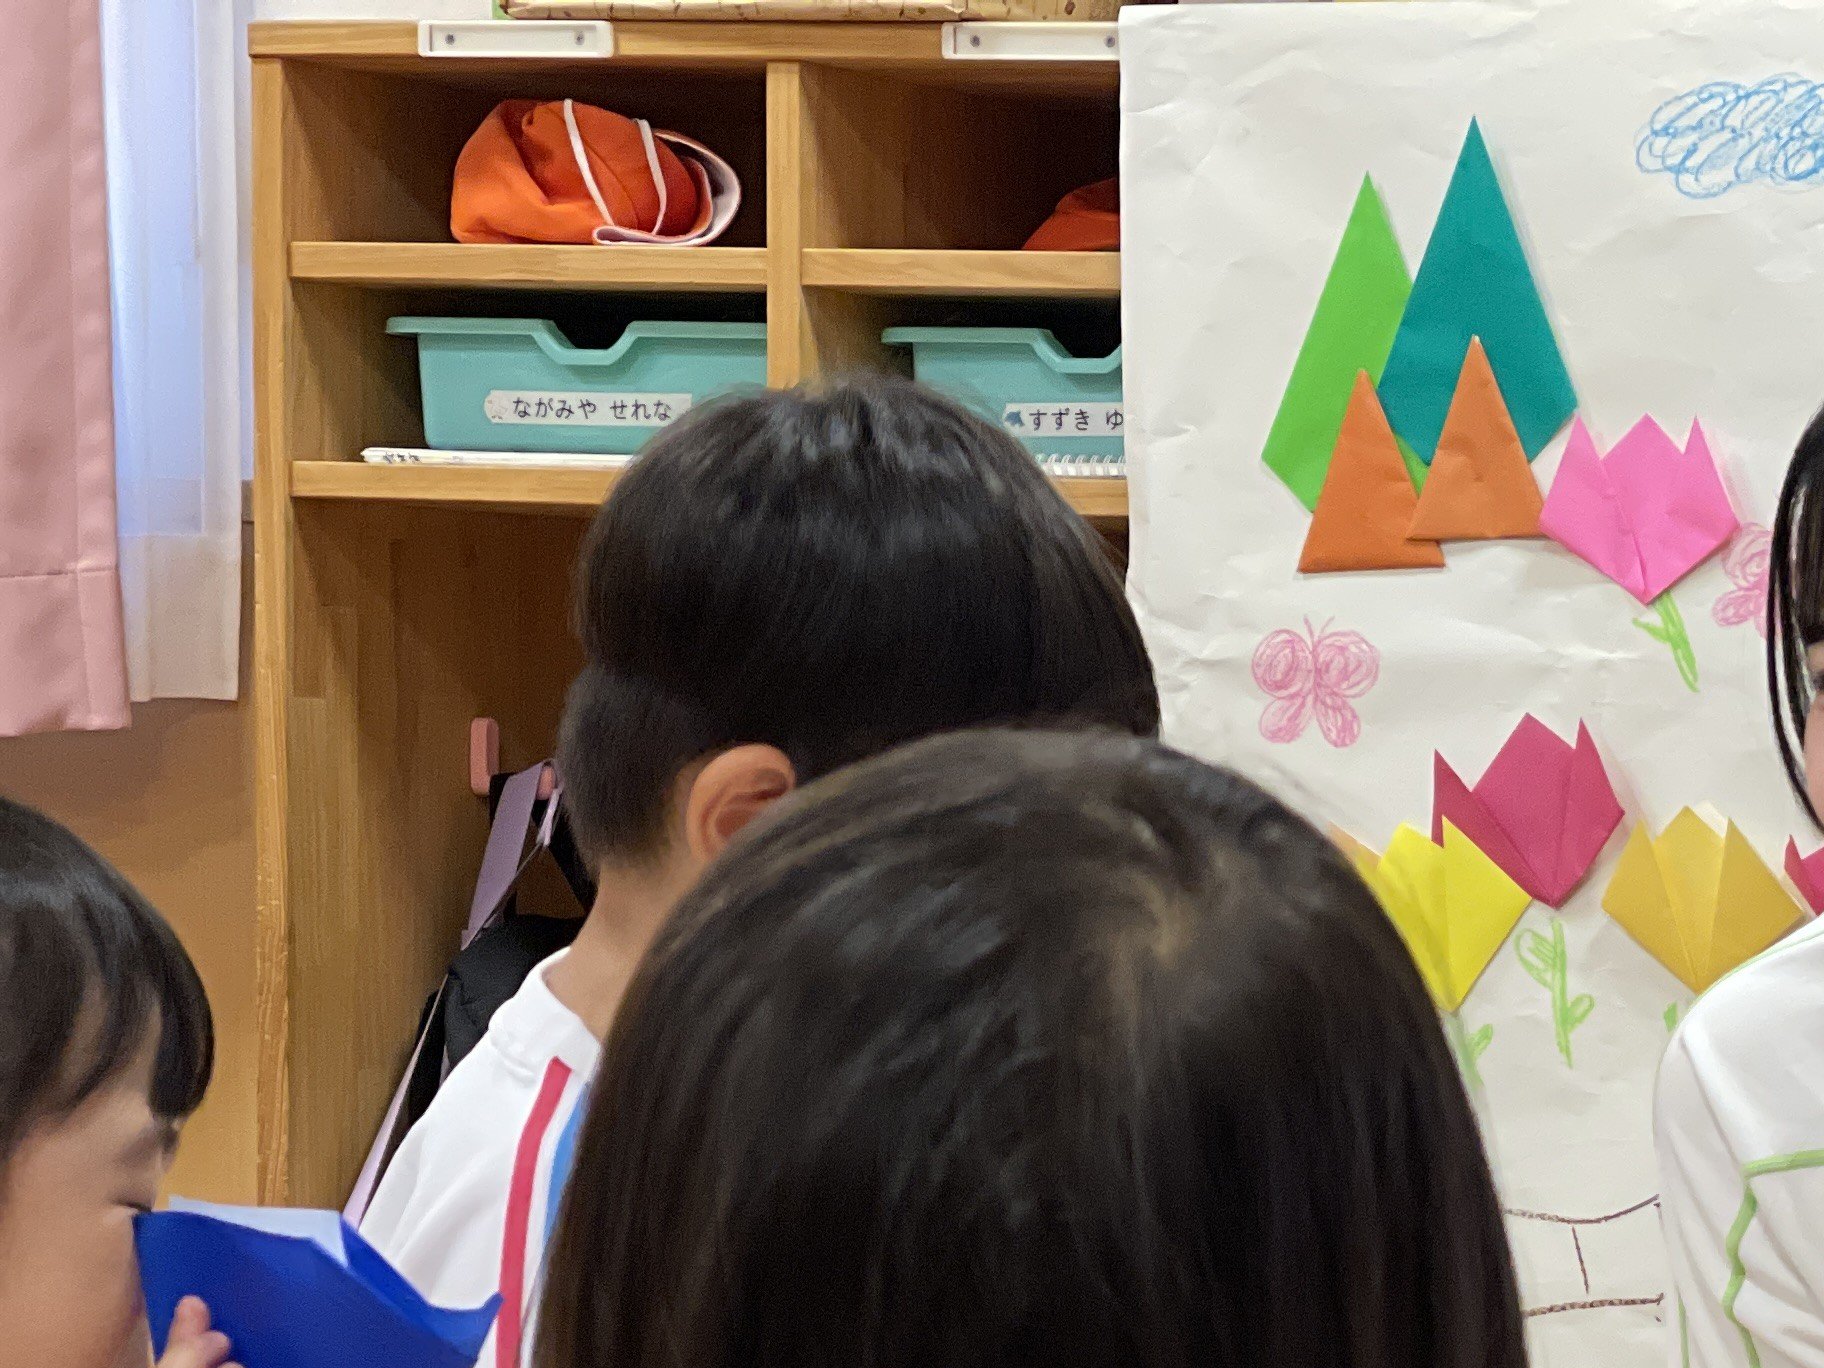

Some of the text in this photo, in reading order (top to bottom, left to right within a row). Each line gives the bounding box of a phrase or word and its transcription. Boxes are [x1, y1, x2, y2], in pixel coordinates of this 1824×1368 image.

[512, 397, 672, 421] ながみや せれな
[1028, 407, 1090, 431] すずき
